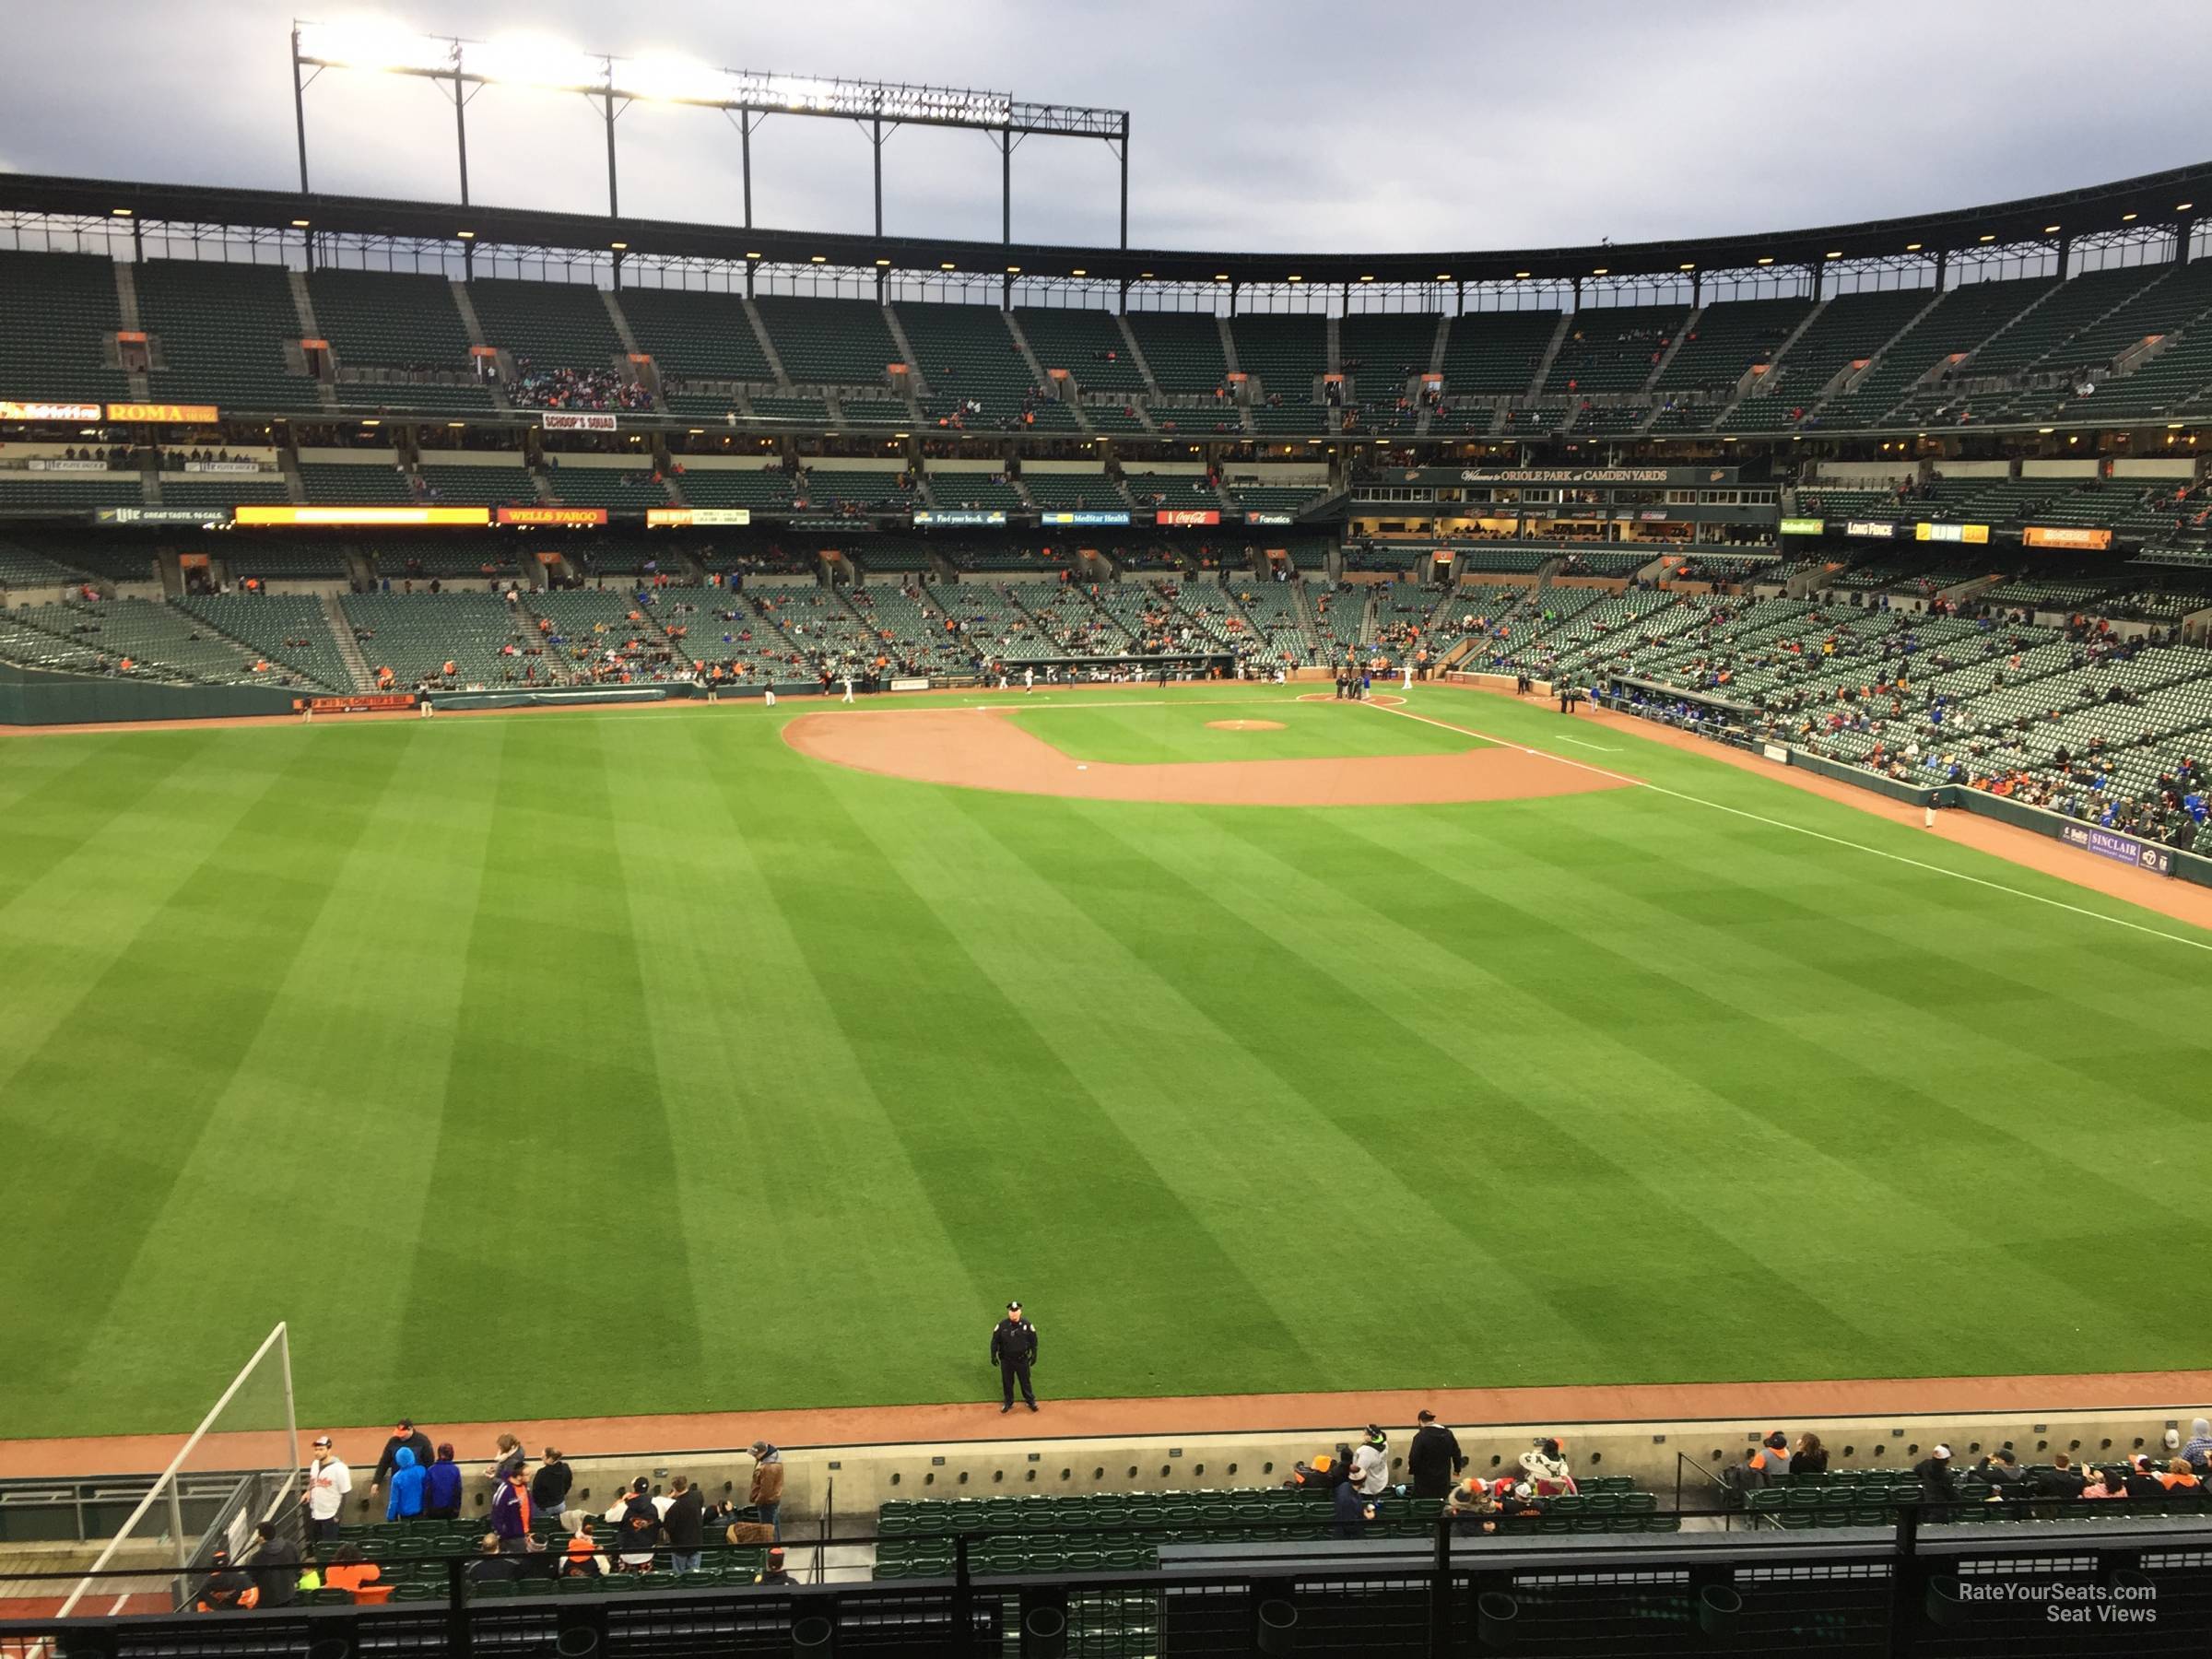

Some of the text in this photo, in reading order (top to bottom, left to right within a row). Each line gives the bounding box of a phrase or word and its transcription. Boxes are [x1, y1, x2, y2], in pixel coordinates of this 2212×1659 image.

[110, 406, 182, 420] ROMA
[546, 416, 614, 429] SCHOOP'S SQUAD
[1501, 471, 1543, 481] ORIOLE
[1544, 471, 1572, 481] PARK
[1583, 471, 1630, 481] CAMDEN
[1631, 471, 1667, 481] YARDS
[116, 508, 141, 523] Lite
[510, 511, 598, 522] WELLS FARGO
[1074, 514, 1102, 523] MedStar
[1104, 514, 1129, 523] Health
[1259, 515, 1290, 524] Fanatics
[2091, 832, 2137, 856] SINCLAIR
